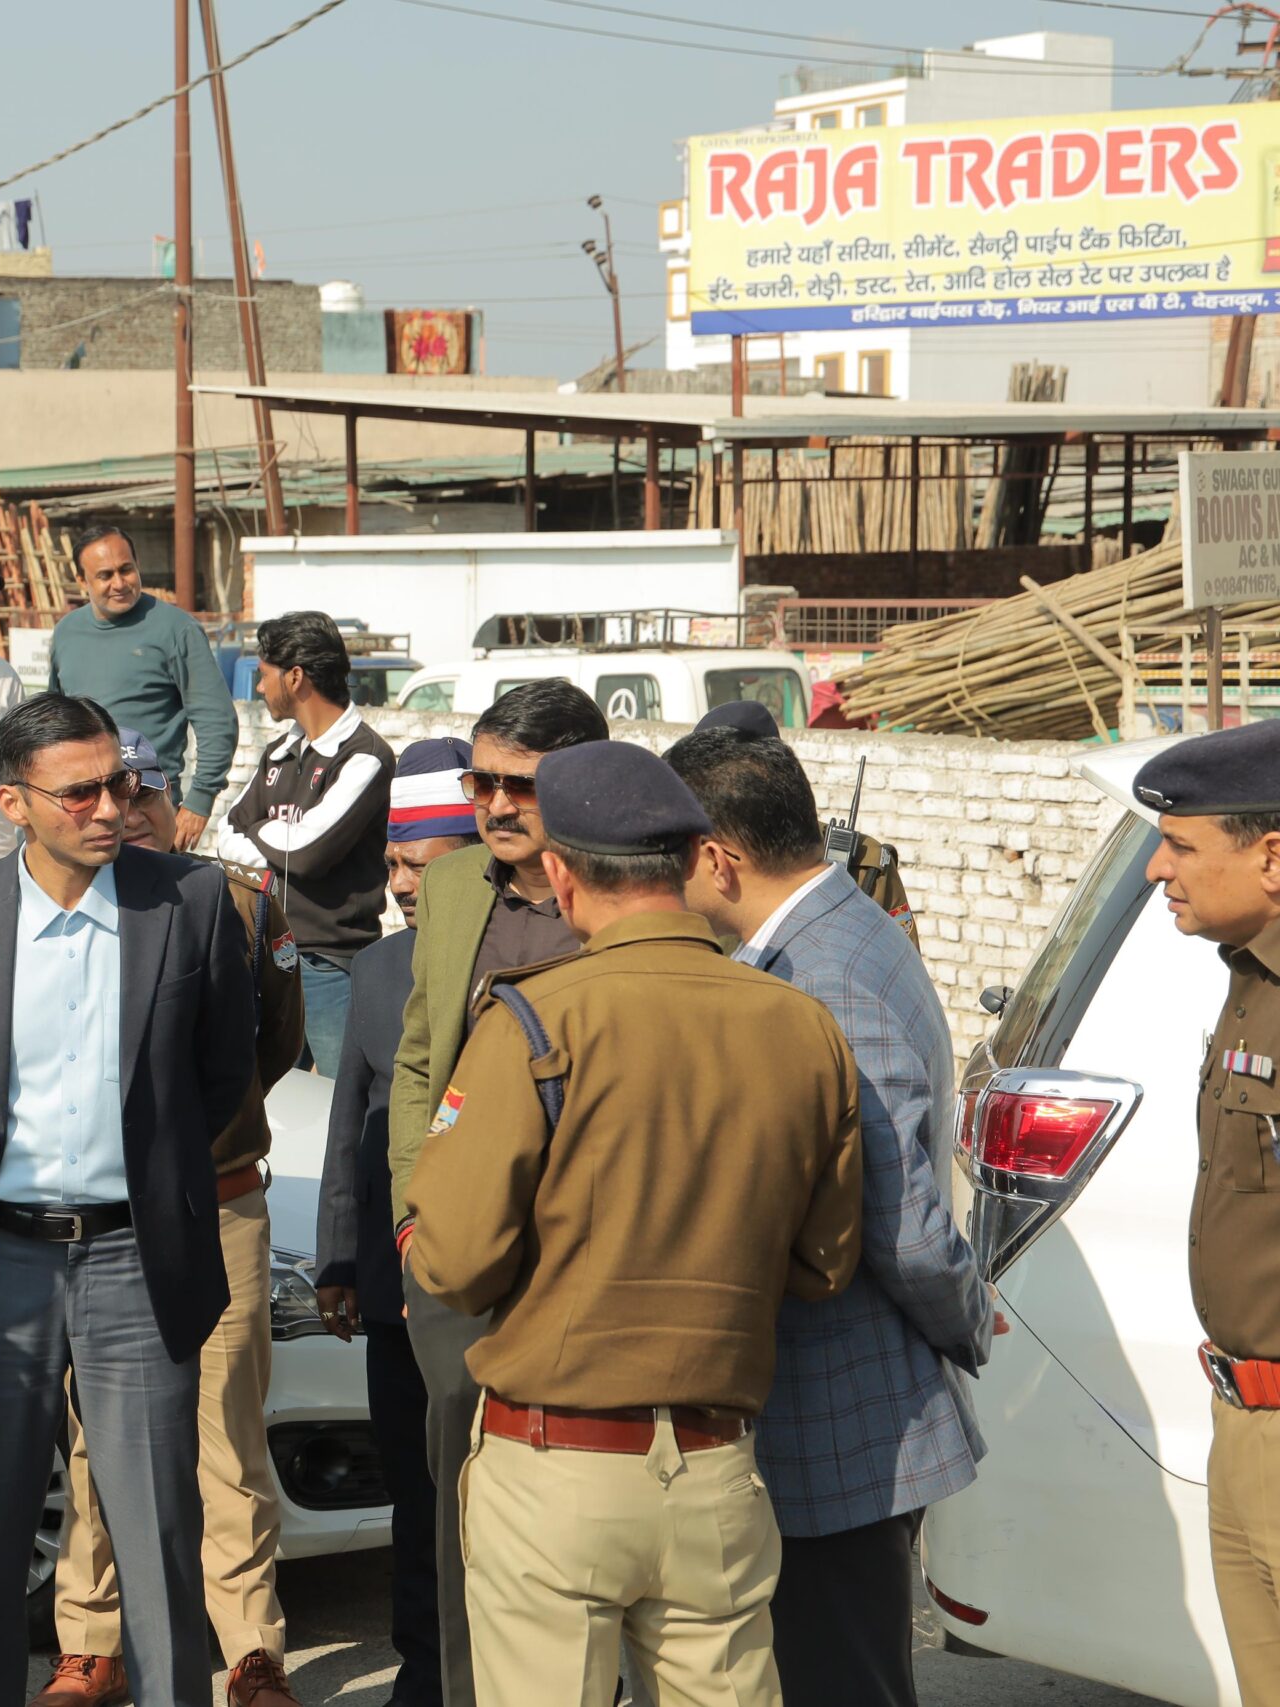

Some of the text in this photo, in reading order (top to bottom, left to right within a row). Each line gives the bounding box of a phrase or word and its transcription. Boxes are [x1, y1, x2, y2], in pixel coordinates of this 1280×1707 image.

[709, 145, 878, 225] RAJA
[902, 124, 1238, 210] TRADERS
[747, 242, 792, 267] हमारे
[837, 237, 896, 261] सरिया,
[1025, 228, 1072, 255] पाईप
[905, 269, 936, 292] रेत,
[943, 265, 986, 291] आदि
[994, 265, 1031, 290] होल
[1038, 262, 1072, 287] सेल
[1079, 261, 1102, 285] रेट
[1109, 265, 1134, 284] पर
[1216, 255, 1231, 281] है
[1211, 467, 1280, 492] SWAGAT GU
[1196, 494, 1263, 544] ROOMS
[1238, 544, 1257, 568] AC
[1260, 543, 1270, 567] &
